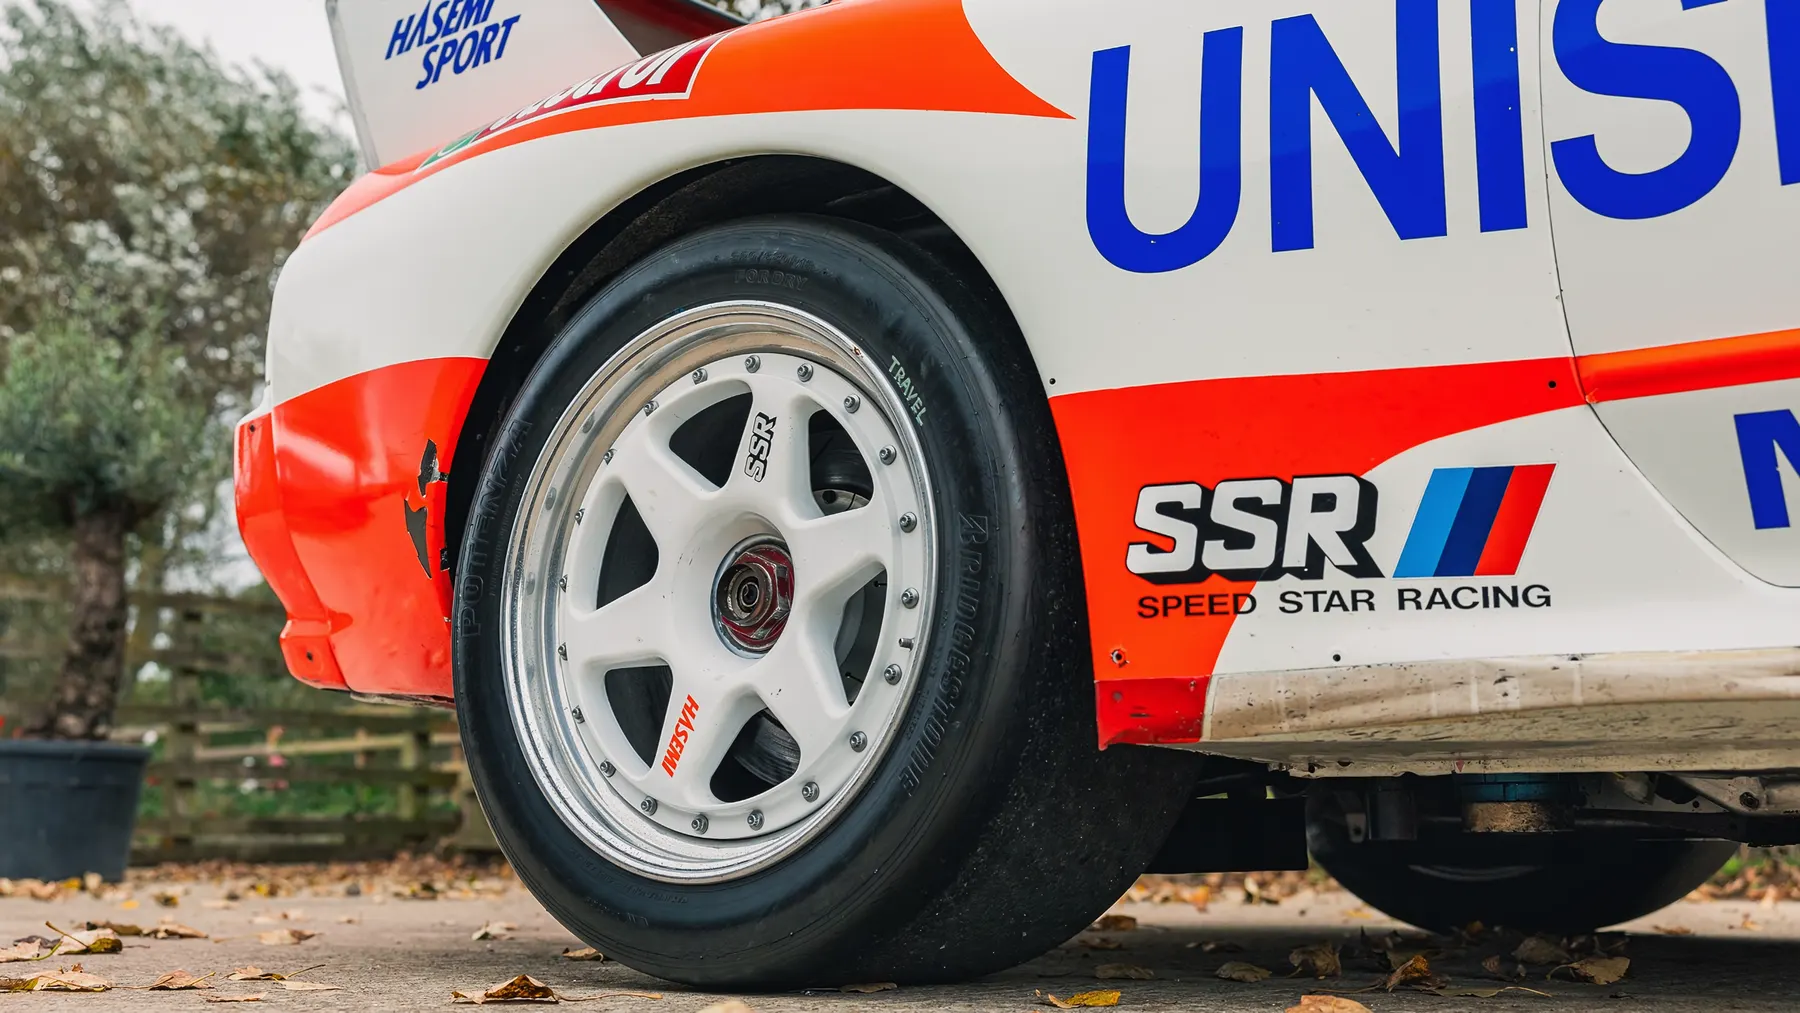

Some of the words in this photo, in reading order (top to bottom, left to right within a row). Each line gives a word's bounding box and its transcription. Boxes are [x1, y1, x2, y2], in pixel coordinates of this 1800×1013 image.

[385, 0, 495, 60] HASEMI
[415, 14, 522, 90] SPORT
[734, 268, 769, 284] FOR
[772, 270, 808, 291] DRY
[889, 355, 926, 426] TRAVEL
[744, 411, 777, 483] SSR
[1125, 473, 1387, 586] SSR
[1137, 593, 1258, 619] SPEED
[1278, 589, 1376, 613] STAR
[1398, 584, 1552, 612] RACING
[899, 511, 989, 797] BRIDGESTONE
[661, 693, 700, 778] HASEMI
